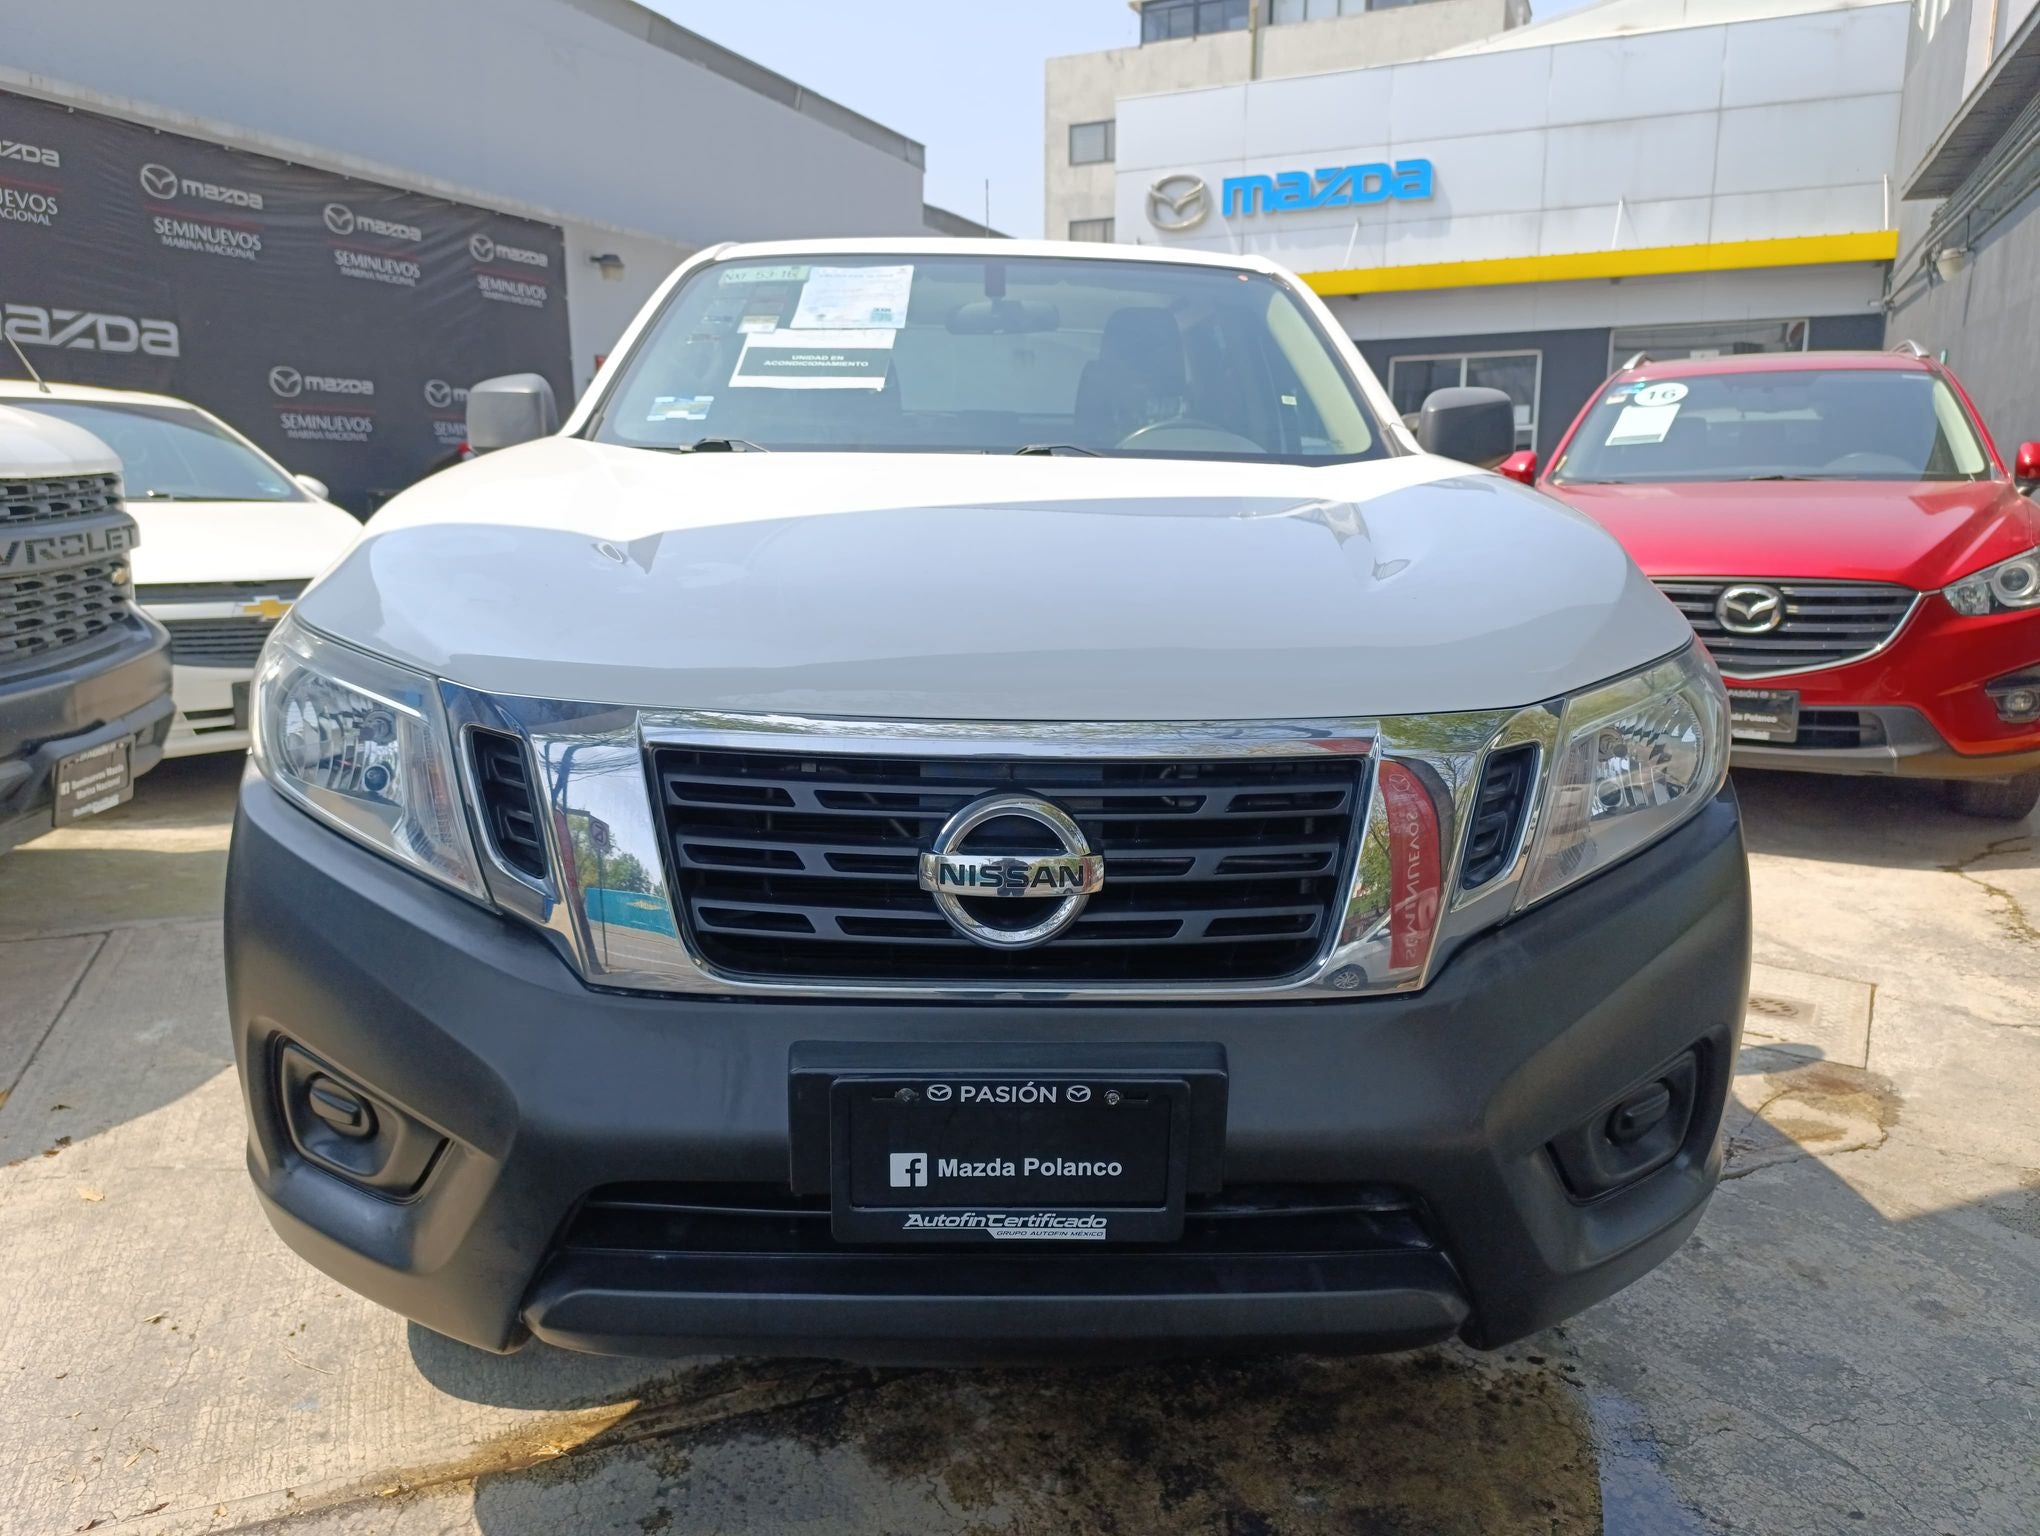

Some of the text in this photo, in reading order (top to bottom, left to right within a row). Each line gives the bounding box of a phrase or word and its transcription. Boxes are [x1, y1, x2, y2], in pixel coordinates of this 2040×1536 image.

[153, 216, 262, 251] SEMINUEVOS
[334, 249, 421, 279] SEMINUEVOS
[0, 303, 180, 358] azda
[1649, 388, 1677, 401] 16
[280, 412, 373, 433] SEMINUEVOS
[939, 863, 1084, 888] NISSAN
[960, 1081, 1057, 1103] PASIÓN
[938, 1158, 1016, 1177] Mazda
[1024, 1157, 1123, 1177] Polanco
